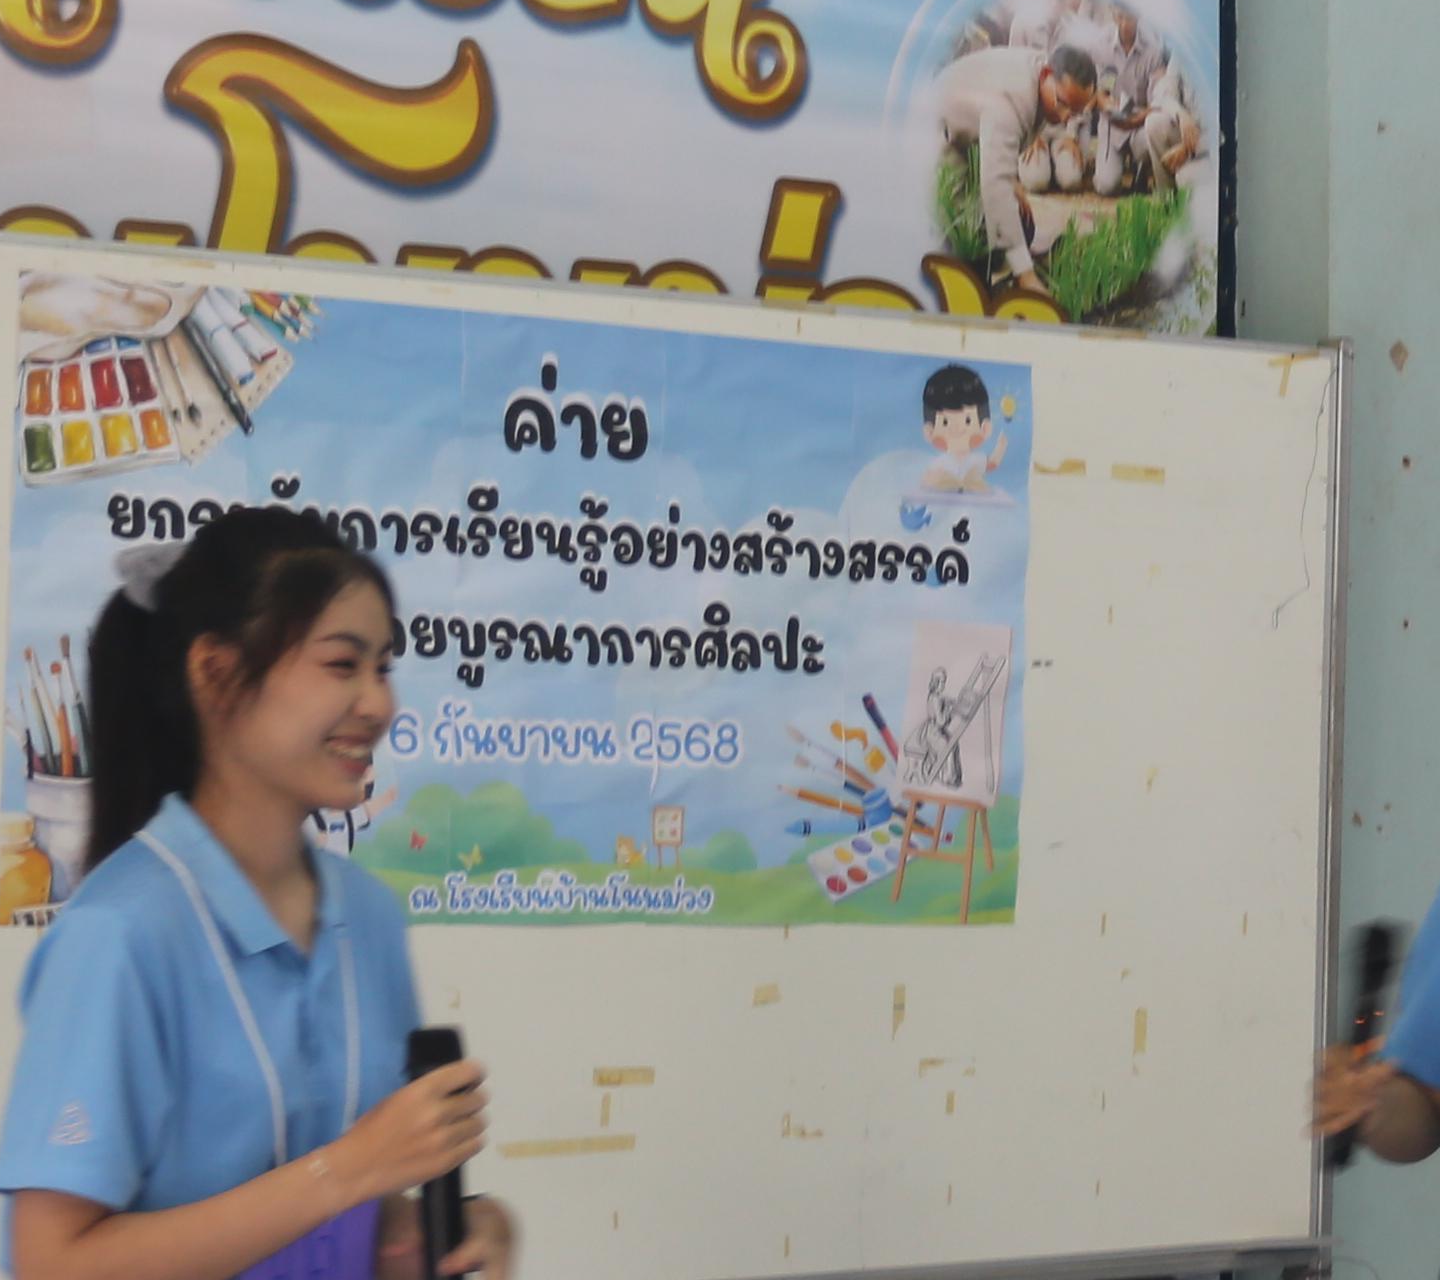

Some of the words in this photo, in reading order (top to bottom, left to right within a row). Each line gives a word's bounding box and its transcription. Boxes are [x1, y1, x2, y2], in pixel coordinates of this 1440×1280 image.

[504, 363, 649, 461] ค่าย
[433, 702, 616, 759] กันยายน
[630, 719, 740, 765] 2568
[411, 886, 439, 910] ณ
[445, 872, 713, 911] โรงเรียนบ้านโนนม่วง
